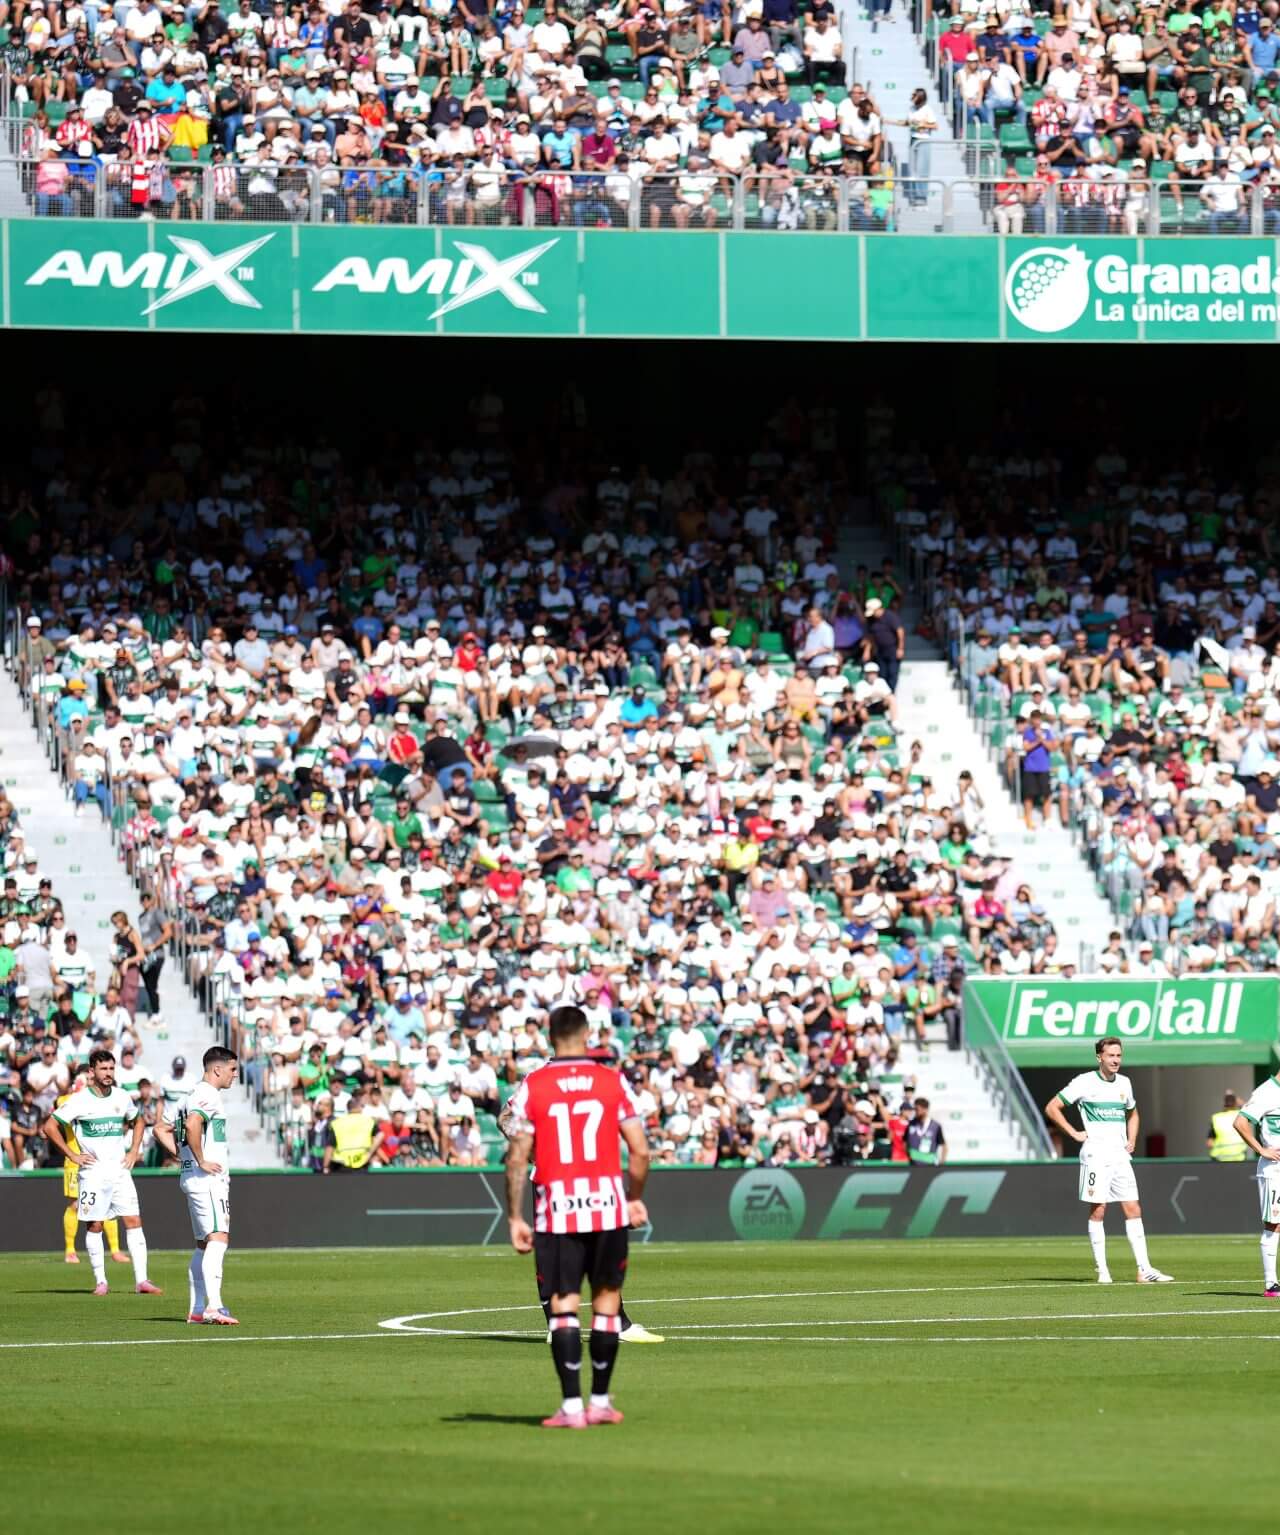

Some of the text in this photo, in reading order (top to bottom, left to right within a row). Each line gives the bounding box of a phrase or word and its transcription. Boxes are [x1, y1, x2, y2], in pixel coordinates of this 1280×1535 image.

[24, 231, 277, 316] AMIX
[311, 236, 561, 321] AMIX
[1094, 298, 1125, 322] La
[1132, 296, 1200, 322] única
[1206, 298, 1245, 322] del
[1013, 981, 1244, 1036] Ferrotall
[548, 1098, 604, 1164] 17
[1088, 1172, 1096, 1186] 8
[80, 1190, 97, 1206] 23
[745, 1185, 791, 1210] EA
[743, 1210, 793, 1226] SPORTS
